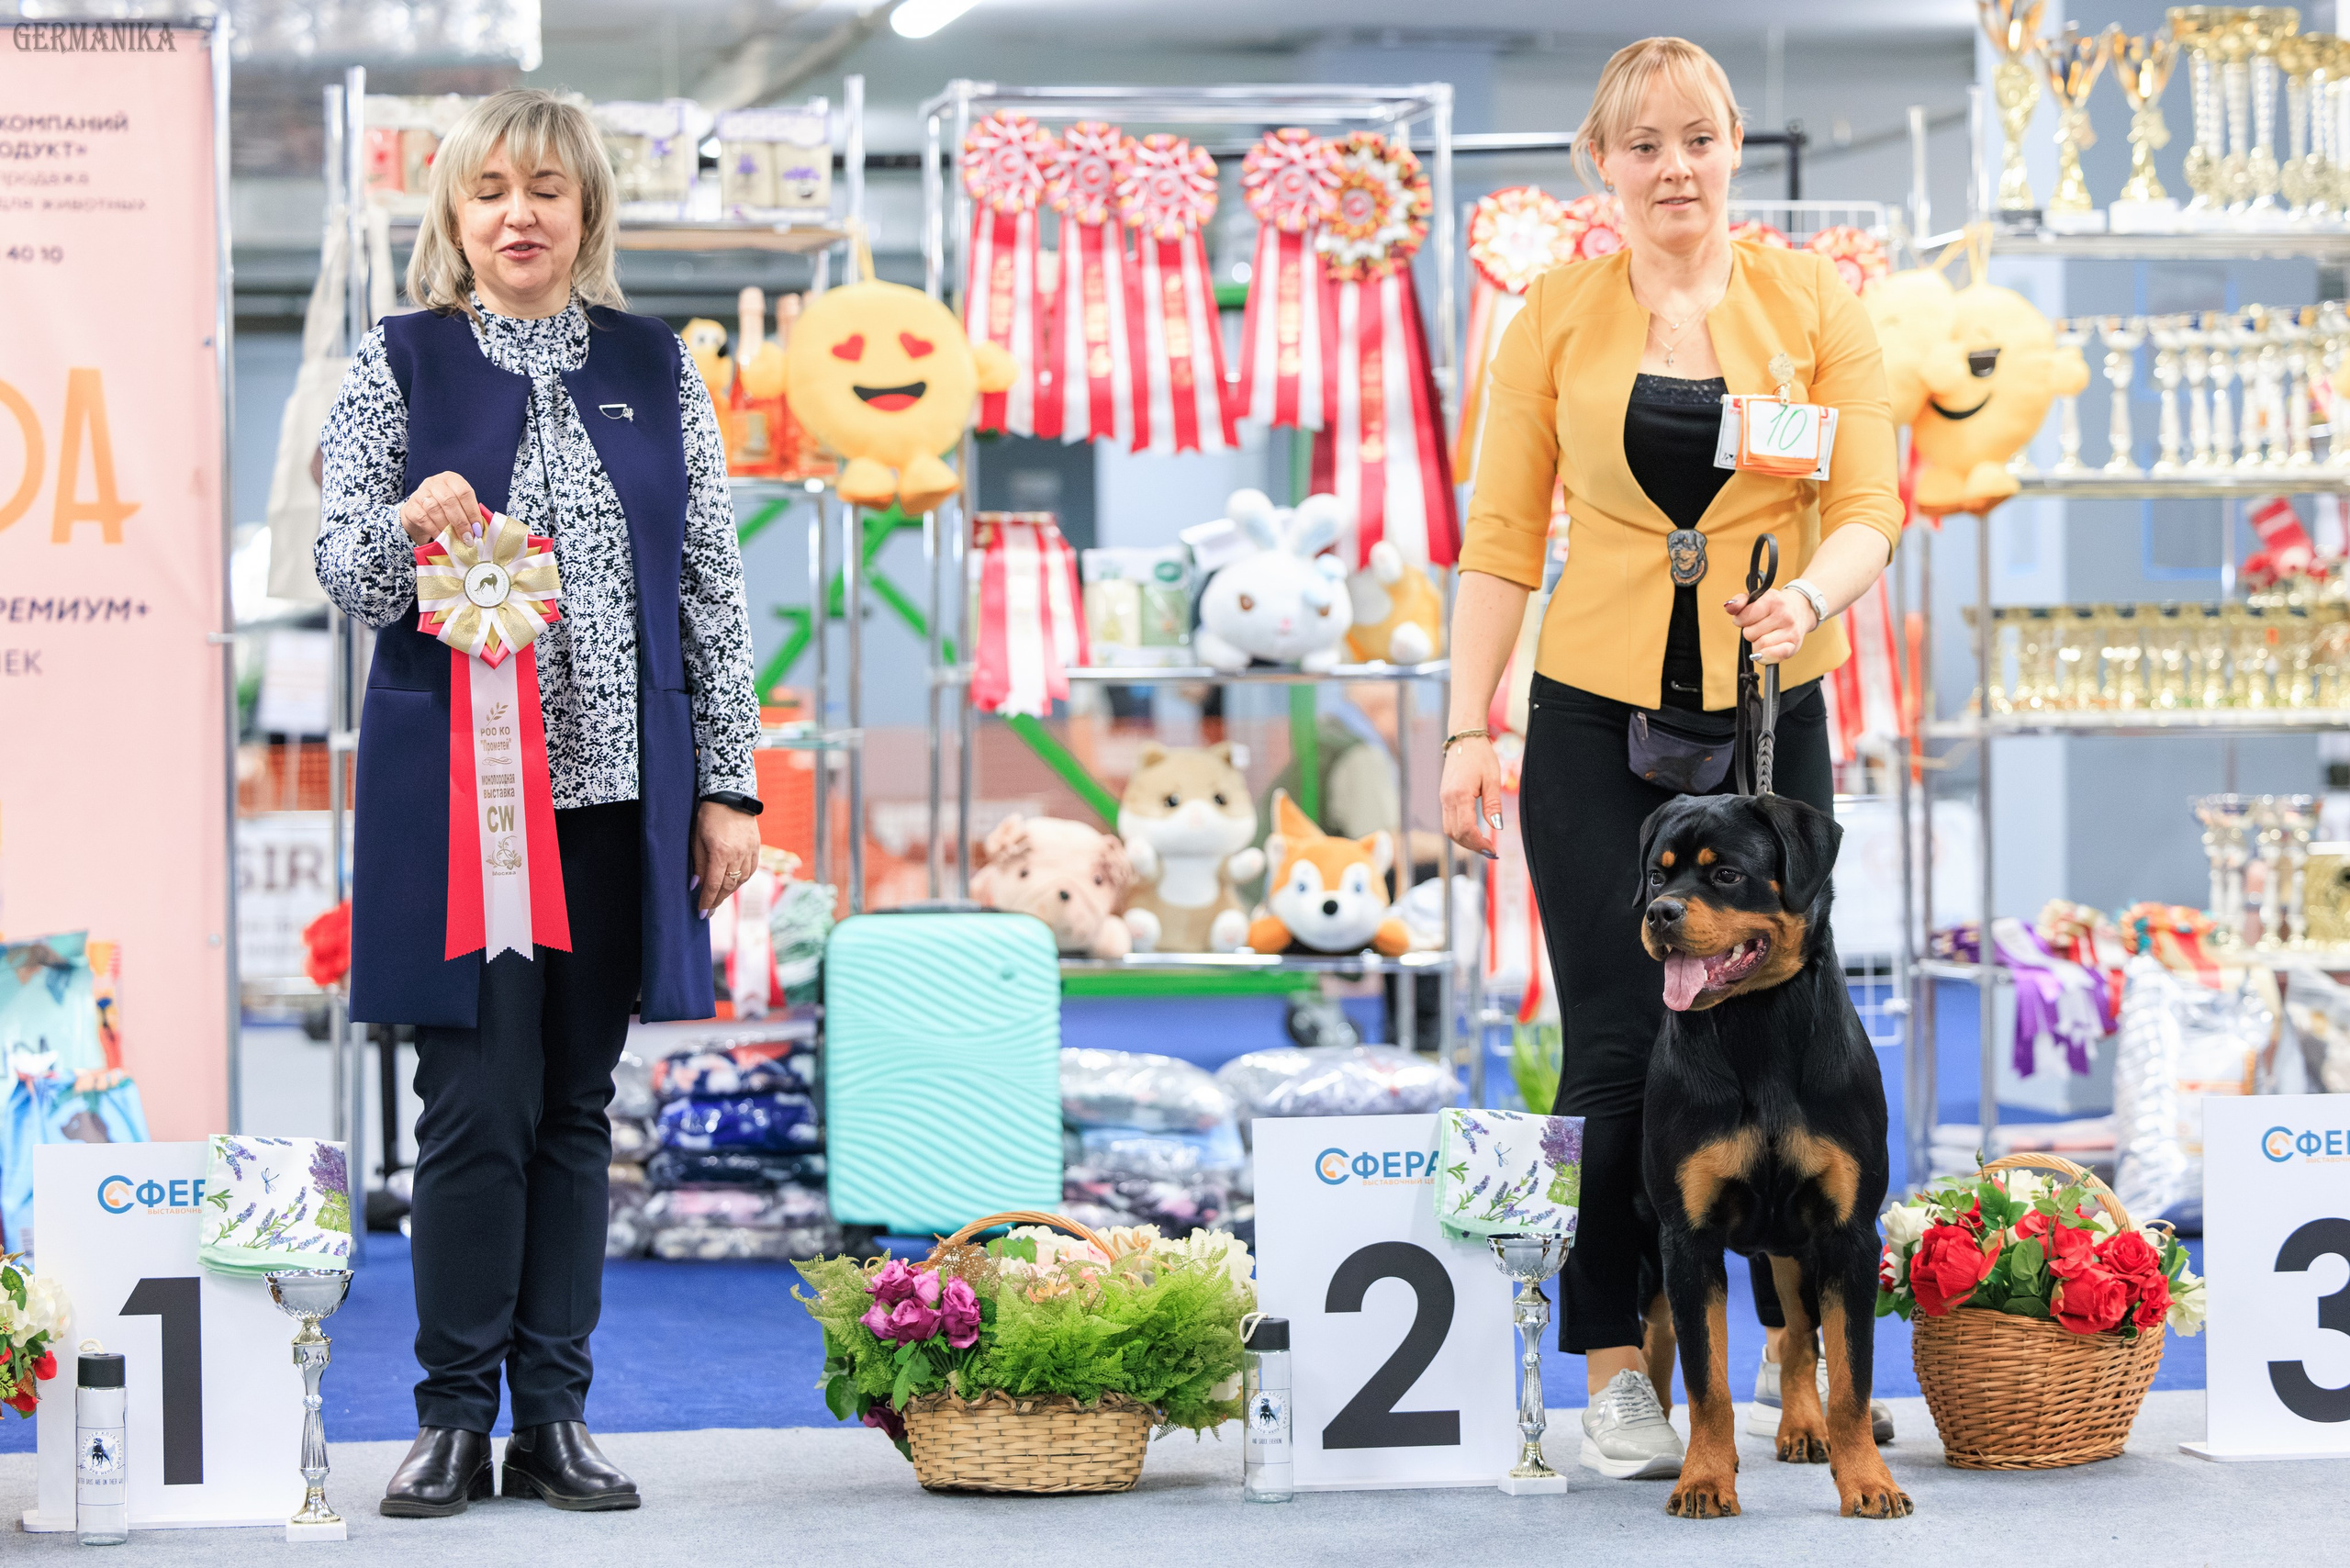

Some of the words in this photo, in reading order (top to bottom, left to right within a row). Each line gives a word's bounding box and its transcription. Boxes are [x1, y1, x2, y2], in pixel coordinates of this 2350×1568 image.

[1767, 405, 1807, 451] 10
[480, 726, 498, 737] РОО
[498, 725, 511, 735] КО
[483, 787, 516, 800] выставка
[487, 804, 515, 834] CW
[2261, 1126, 2350, 1163] СФЕ
[1362, 1178, 1422, 1186] ВЫСТАВОЧНЫЙ
[2267, 1217, 2350, 1423] 3
[1323, 1240, 1461, 1450] 2
[118, 1276, 205, 1485] 1
[101, 1431, 117, 1440] КЛУБ
